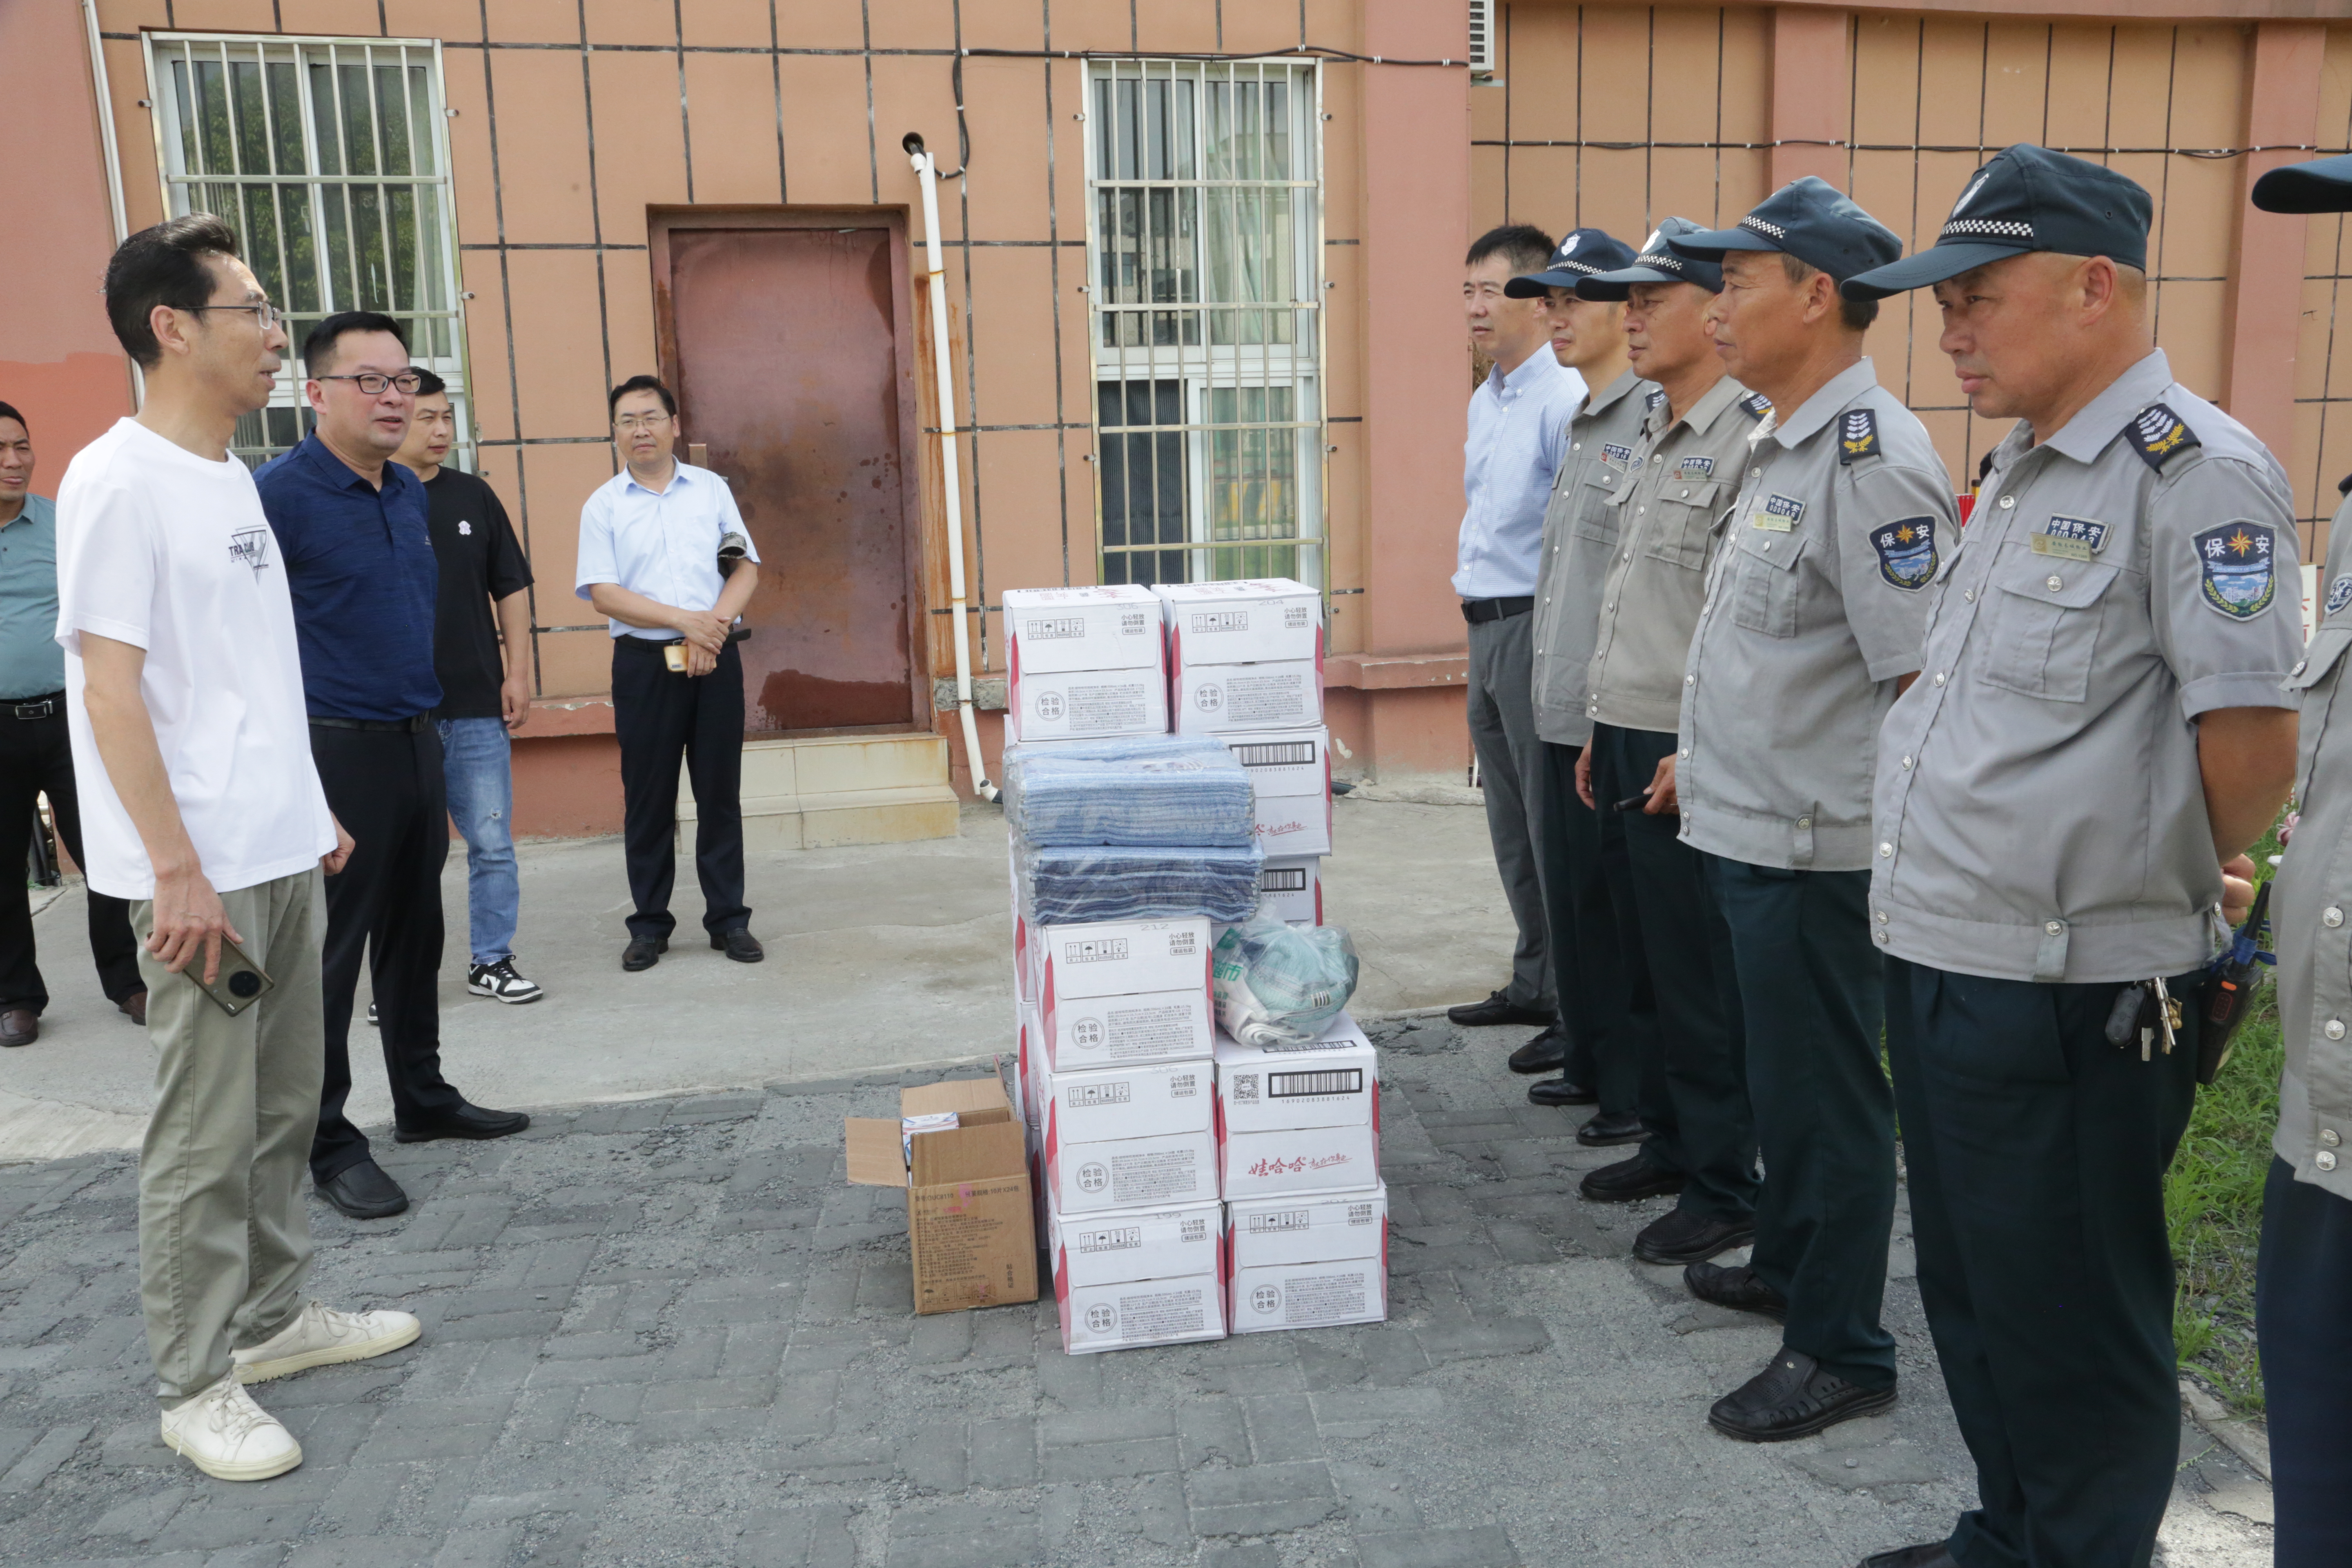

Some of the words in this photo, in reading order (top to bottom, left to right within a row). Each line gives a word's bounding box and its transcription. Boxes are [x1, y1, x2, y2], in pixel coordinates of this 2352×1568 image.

[1606, 445, 1630, 455] 中国保安
[1771, 497, 1800, 512] 中国保安
[1770, 505, 1796, 518] 000046
[2051, 519, 2102, 537] 中国保安
[229, 544, 244, 557] TRA
[1200, 690, 1218, 698] 检验
[1041, 697, 1059, 706] 检验
[1200, 699, 1218, 707] 合格
[1042, 707, 1060, 715] 合格
[1078, 1023, 1098, 1032] 检验
[1079, 1034, 1099, 1043] 合格
[1248, 1156, 1306, 1176] 娃哈哈
[1082, 1169, 1102, 1178] 检验
[1083, 1178, 1103, 1188] 合格
[1180, 1225, 1205, 1234] 请勿倒置
[1256, 1291, 1275, 1299] 检验
[1257, 1300, 1275, 1309] 合格
[1091, 1309, 1110, 1318] 检验
[1092, 1318, 1111, 1327] 合格
